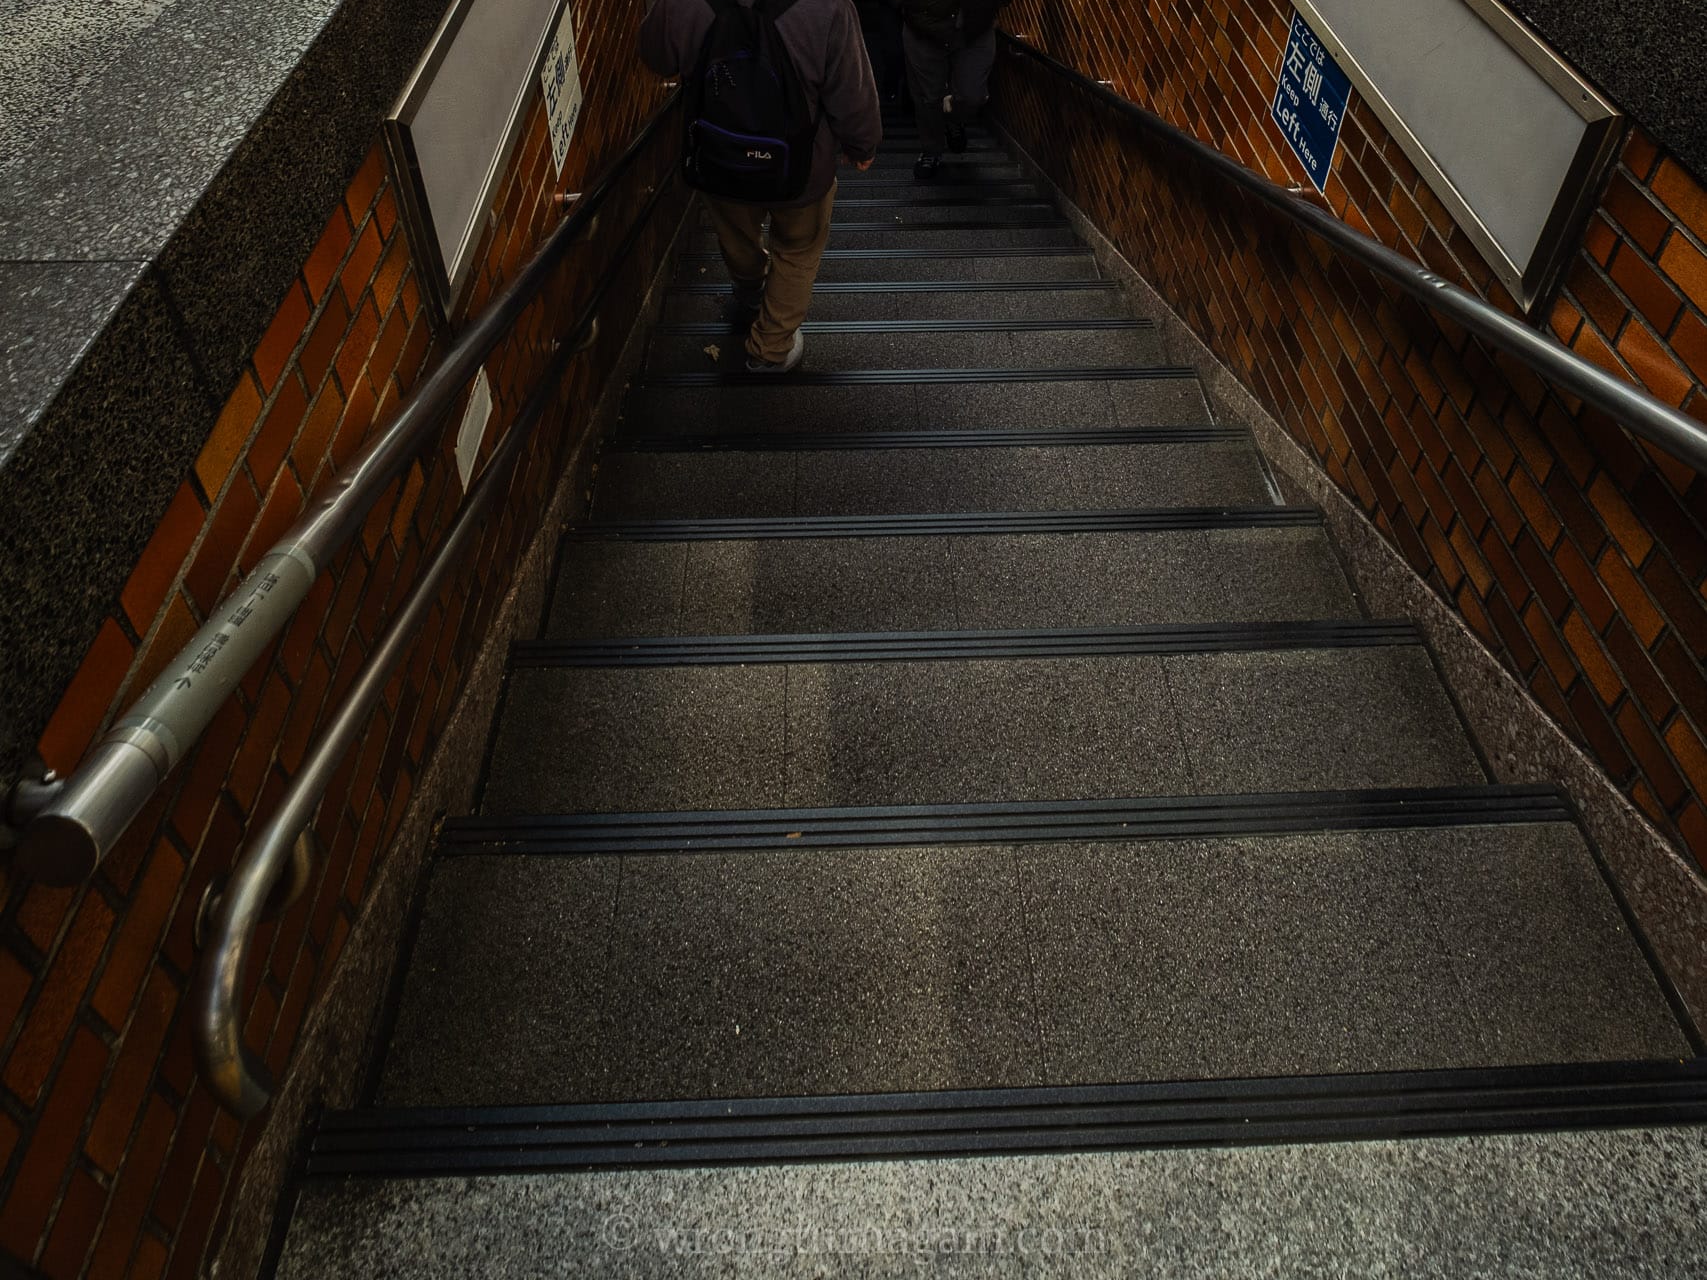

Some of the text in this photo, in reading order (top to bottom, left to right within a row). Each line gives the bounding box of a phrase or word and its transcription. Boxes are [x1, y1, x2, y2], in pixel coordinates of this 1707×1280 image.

[1293, 18, 1326, 66] ここでは
[1281, 74, 1300, 107] Keep
[1286, 40, 1338, 132] 左側通行
[555, 122, 570, 166] Left
[746, 149, 772, 161] FILA
[1276, 94, 1318, 171] Left Here
